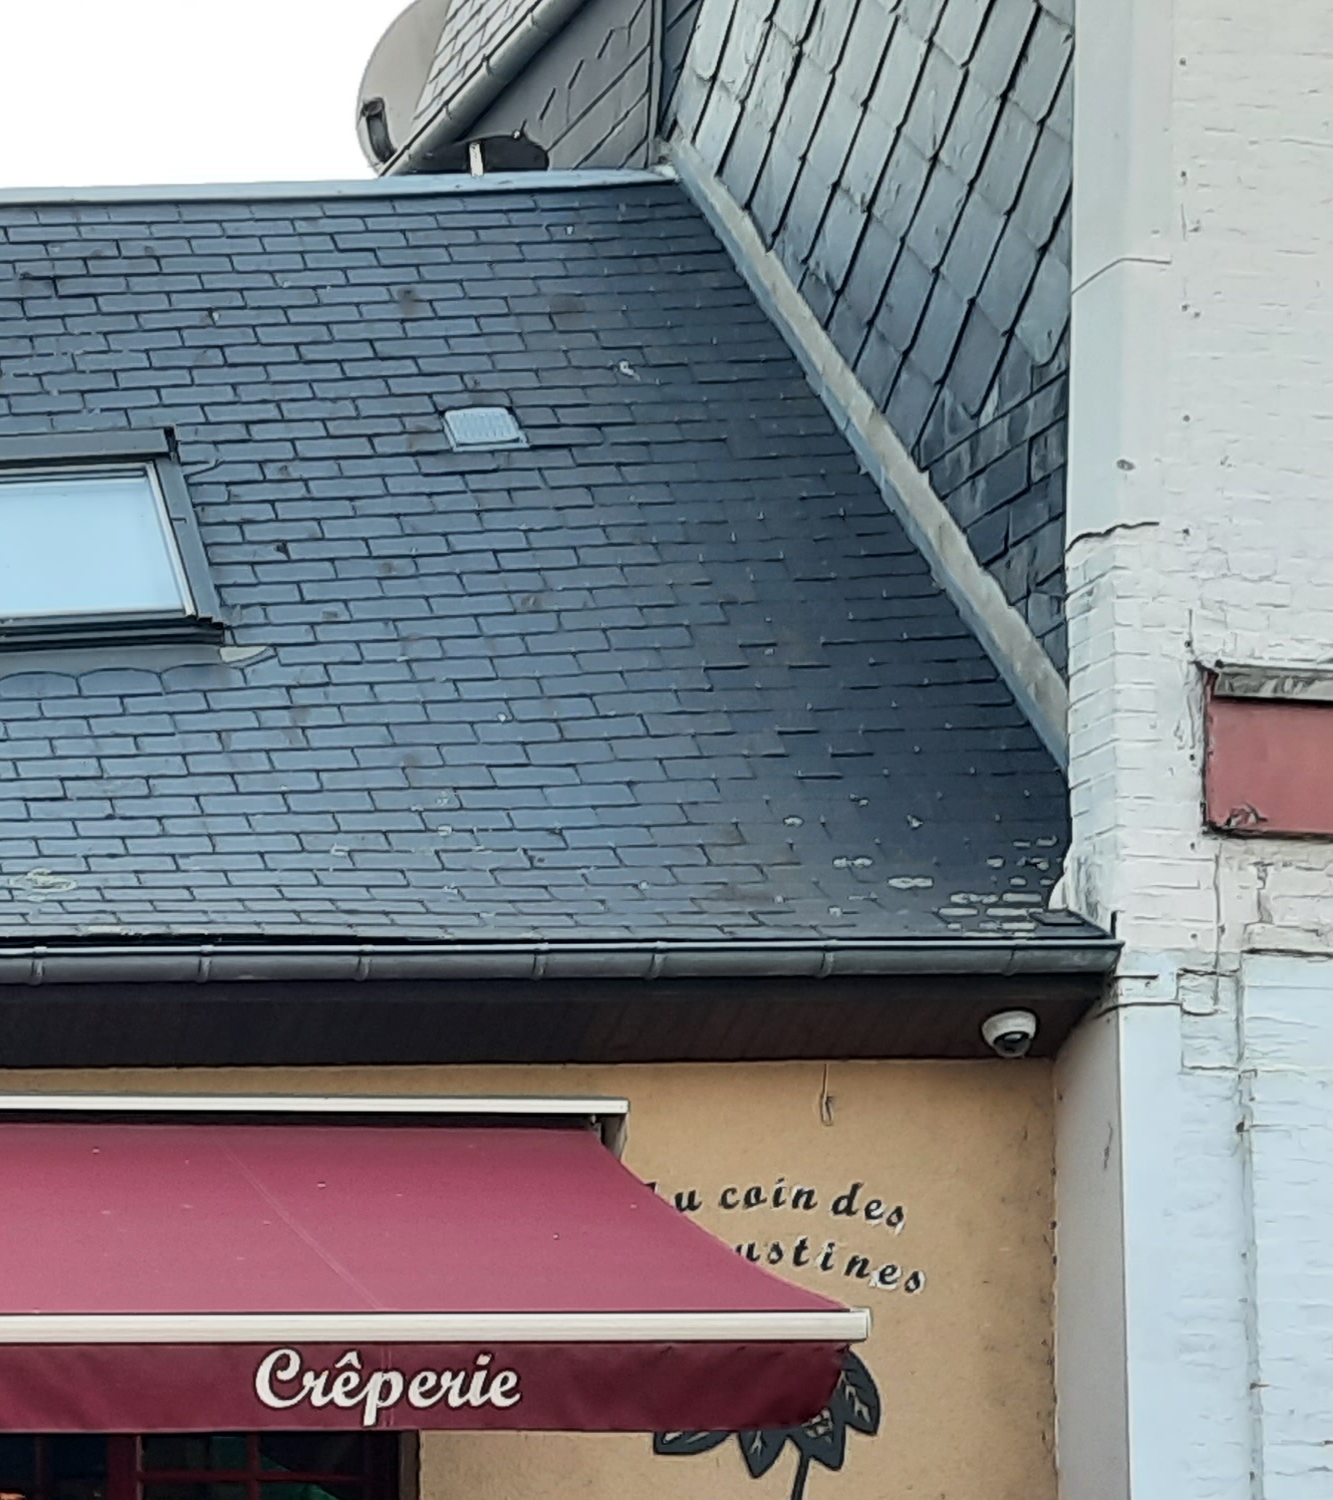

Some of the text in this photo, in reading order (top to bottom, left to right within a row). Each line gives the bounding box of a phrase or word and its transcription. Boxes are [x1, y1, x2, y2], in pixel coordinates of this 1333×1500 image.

[719, 1177, 818, 1211] coin
[831, 1182, 905, 1228] des
[255, 1348, 521, 1426] Crêperie
